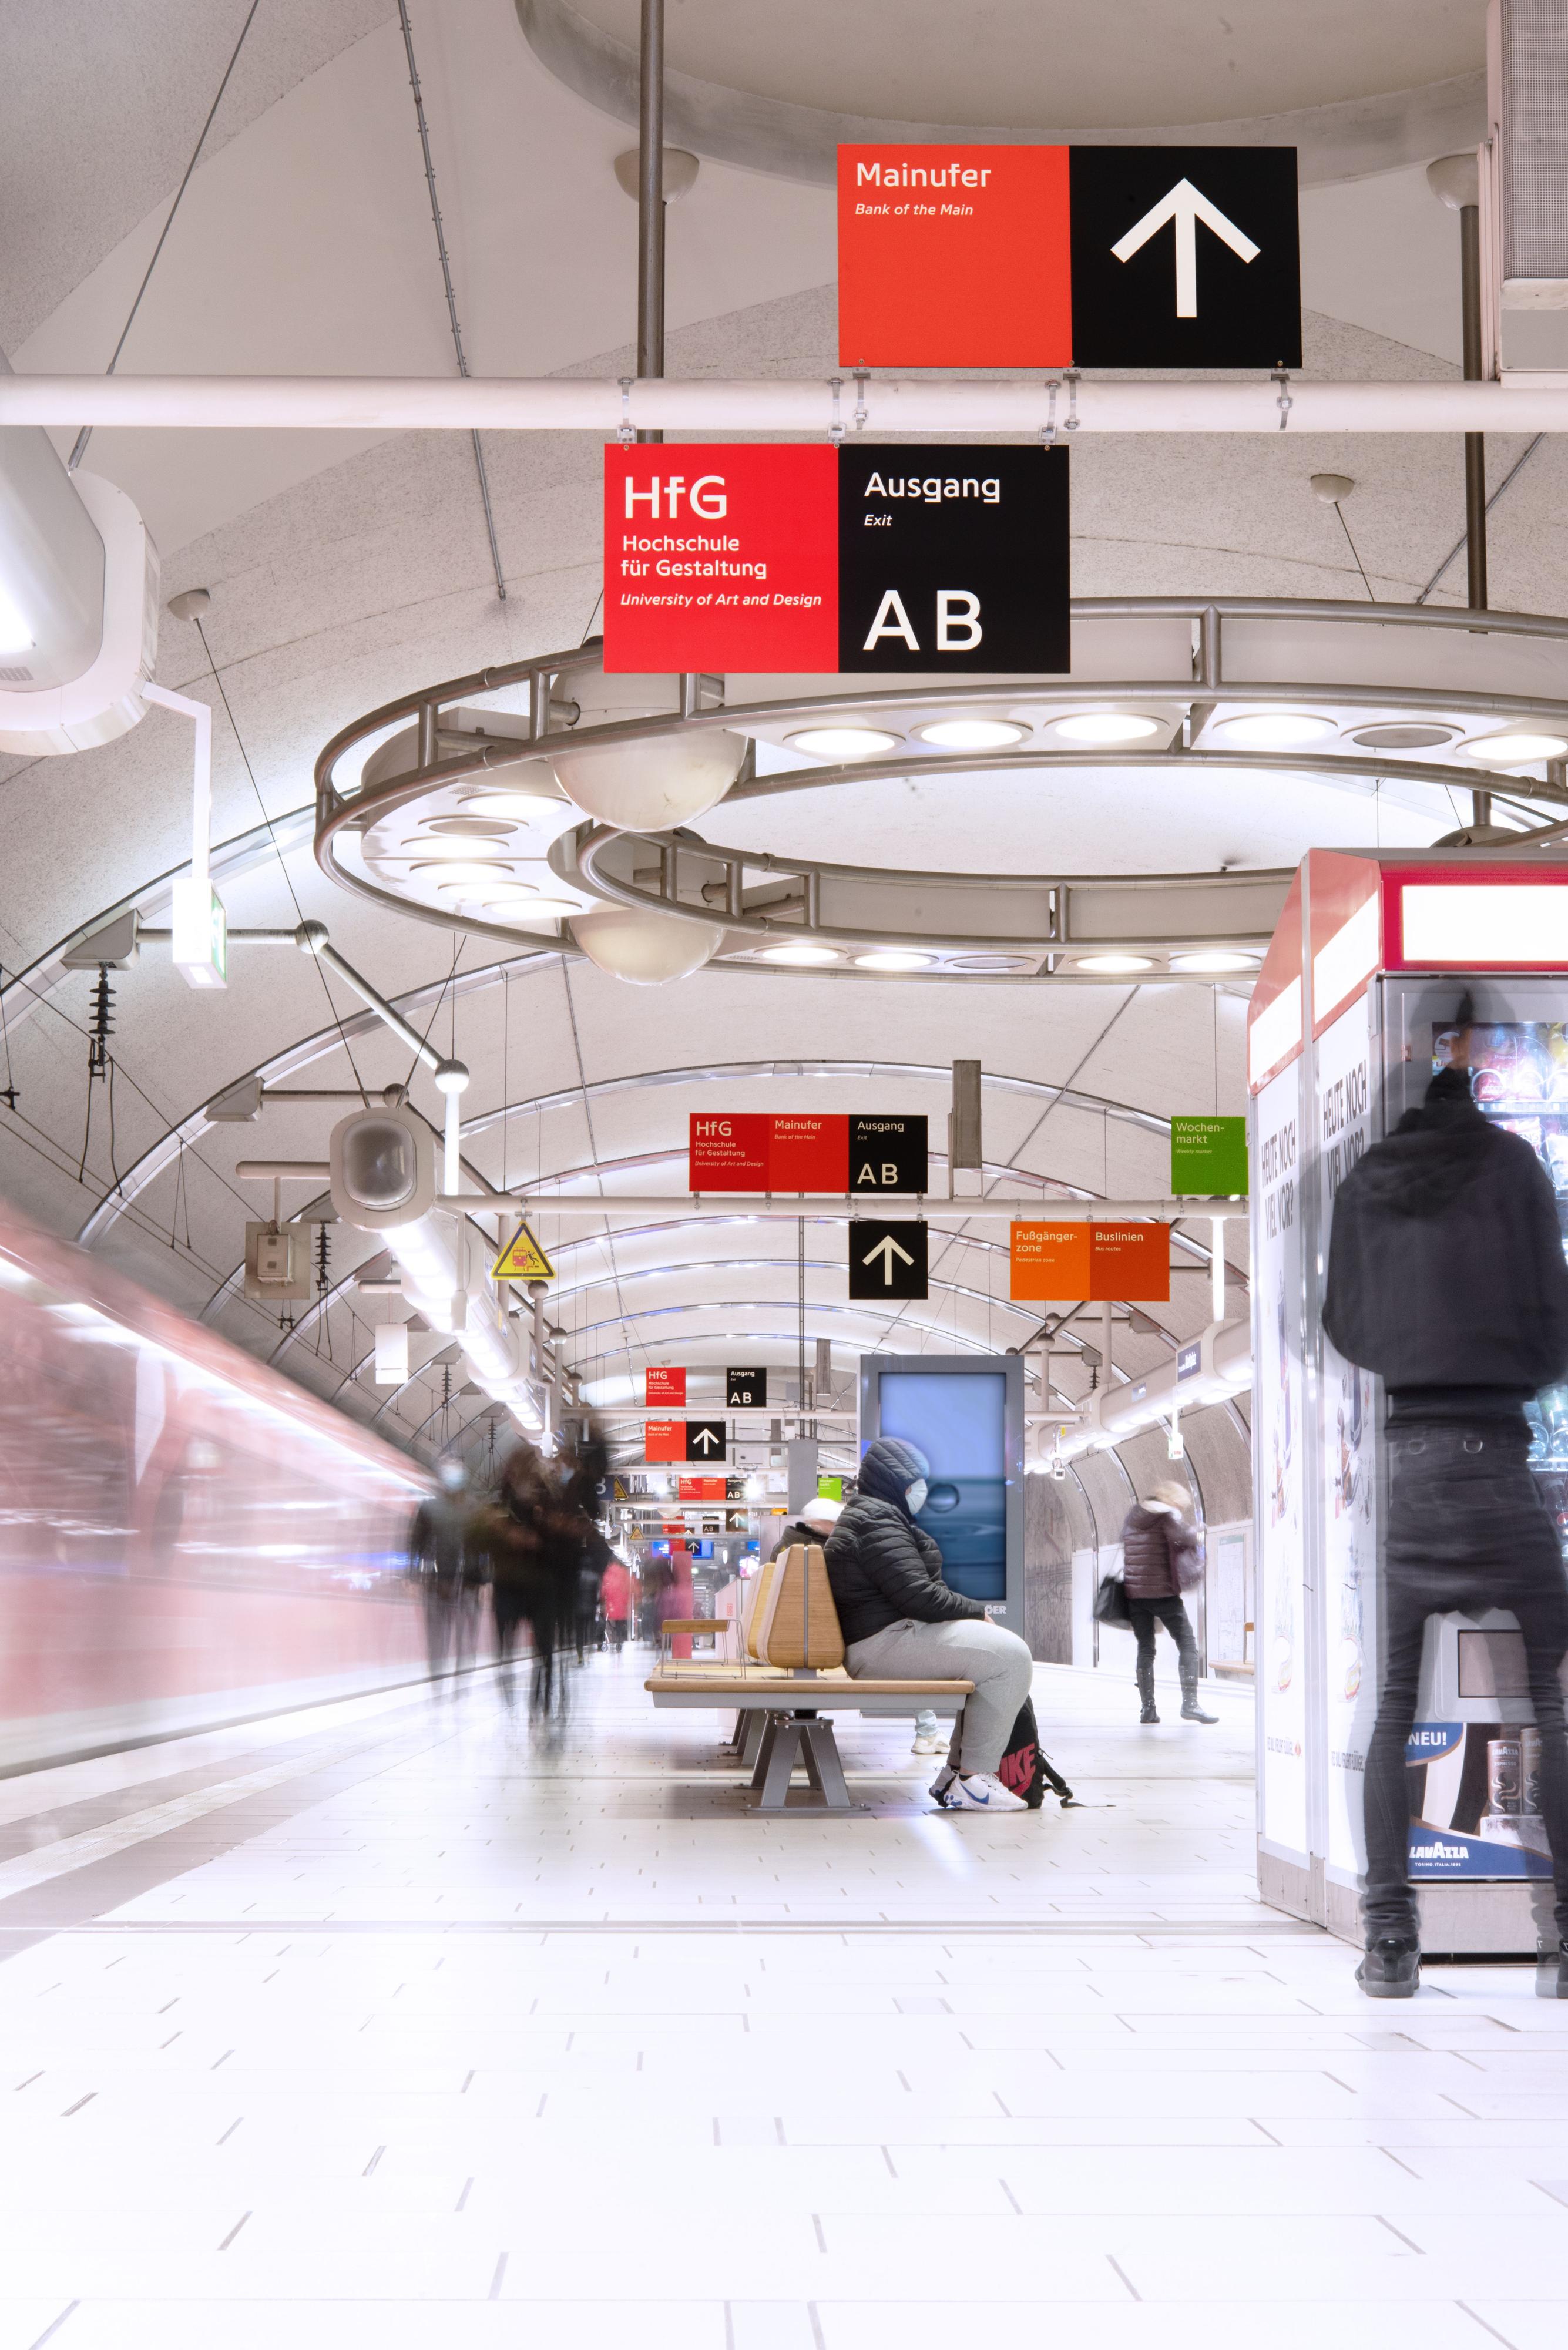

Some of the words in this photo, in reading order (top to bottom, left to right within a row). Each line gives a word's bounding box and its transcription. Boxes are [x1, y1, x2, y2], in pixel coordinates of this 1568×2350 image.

[857, 163, 992, 188] Mainufer
[855, 203, 891, 215] Bank
[894, 204, 910, 215] of
[913, 204, 936, 216] the
[940, 204, 973, 216] Main
[864, 472, 1000, 503] Ausgang
[625, 475, 727, 519] HfG
[864, 514, 893, 526] Exit
[623, 535, 740, 552] Hochschule
[620, 559, 650, 576] für
[656, 559, 767, 580] Gestaltung
[620, 593, 693, 607] University
[696, 593, 713, 606] of
[715, 593, 739, 605] Art
[742, 593, 770, 606] and
[773, 593, 822, 608] Design
[862, 590, 921, 650] A
[936, 590, 983, 650] B
[1323, 1079, 1344, 1141] HEUTE
[1346, 1059, 1366, 1124] NOCH
[696, 1120, 732, 1137] HfG
[775, 1120, 822, 1130] Mainufer
[857, 1121, 904, 1132] Ausgang
[1176, 1122, 1224, 1132] Wochen-
[1176, 1134, 1208, 1144] markt
[707, 1149, 746, 1157] Gestaltung
[1261, 1133, 1278, 1189] HEUTE
[1279, 1118, 1296, 1175] NOCH
[857, 1163, 877, 1184] A
[882, 1163, 898, 1184] B
[1265, 1193, 1277, 1241] VIEL
[1278, 1179, 1294, 1233] VOR?
[1016, 1231, 1077, 1243] Fußgänger-
[1096, 1231, 1144, 1241] Buslinien
[649, 1371, 667, 1380] HfG
[730, 1392, 741, 1404] A
[743, 1392, 752, 1404] B
[1408, 1731, 1447, 1745] NEU!
[993, 1742, 1036, 1787] IKE
[1409, 1842, 1469, 1859] LAVAZZA
